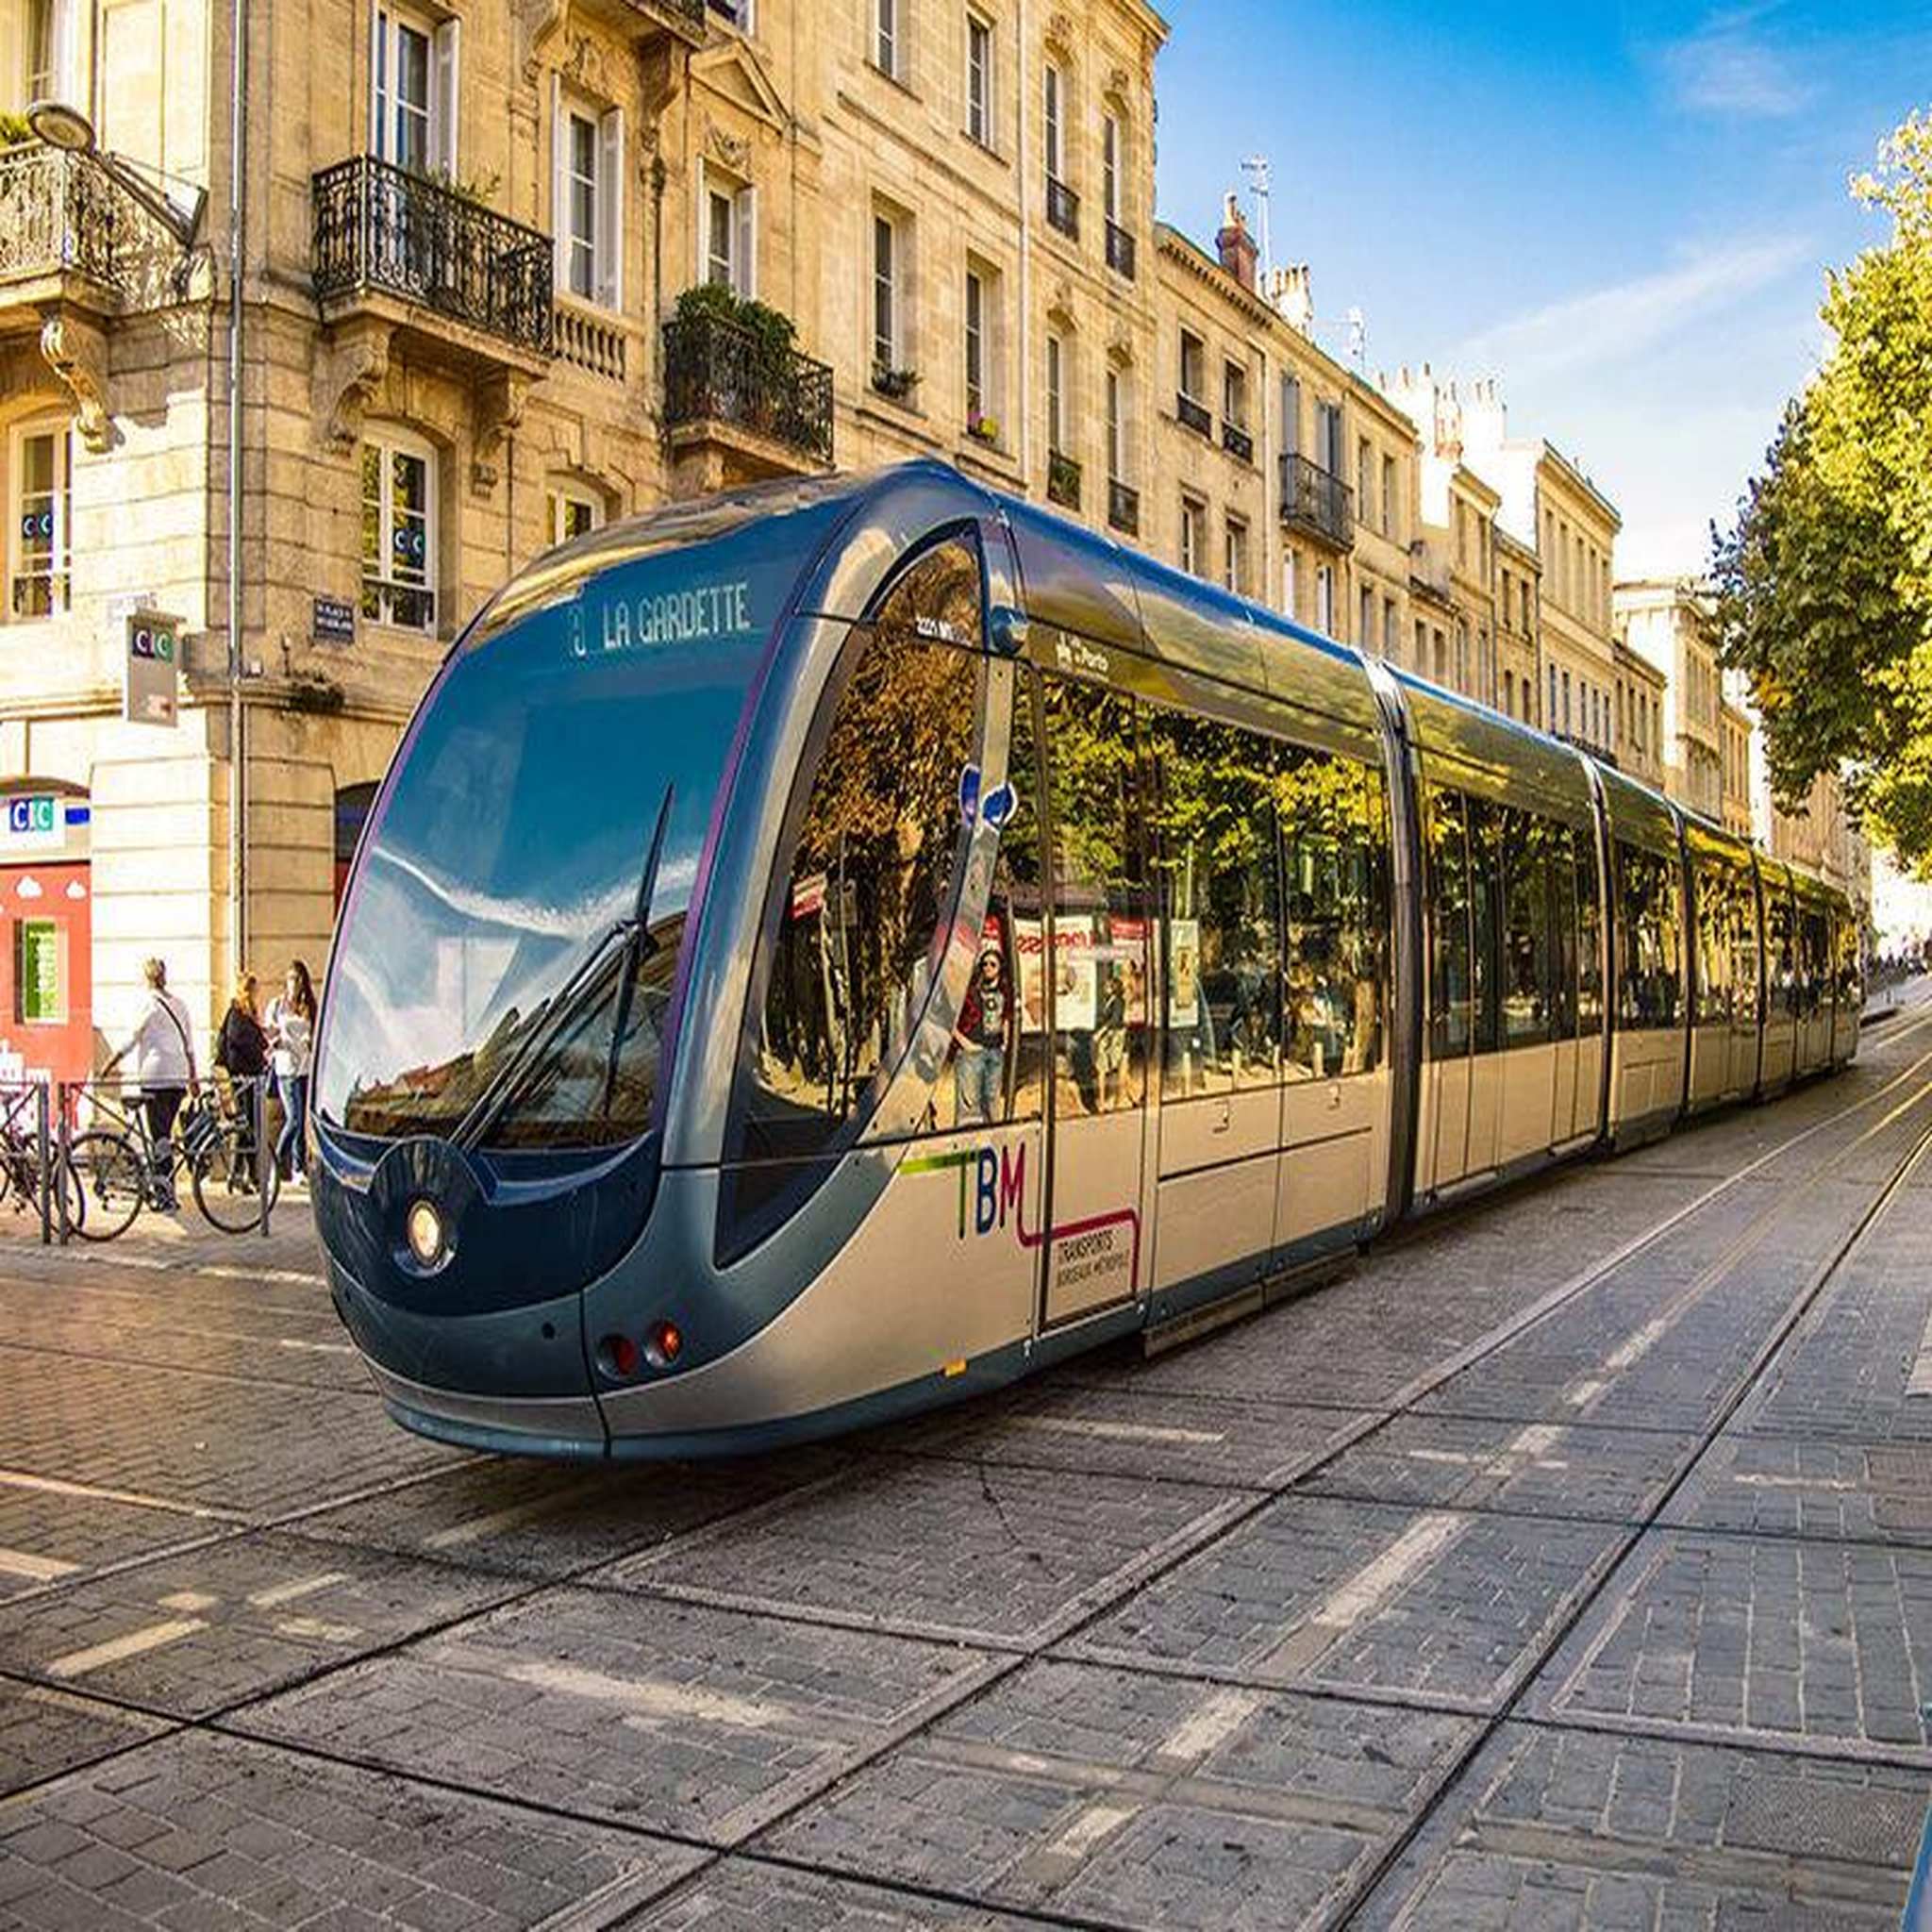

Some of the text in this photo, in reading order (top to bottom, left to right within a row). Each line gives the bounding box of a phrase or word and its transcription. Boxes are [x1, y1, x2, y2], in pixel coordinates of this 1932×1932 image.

[23, 514, 51, 537] CC
[603, 601, 631, 648] LA
[638, 581, 751, 643] GARDETTE
[135, 629, 171, 658] CIC
[12, 799, 51, 830] CIC
[941, 1141, 1029, 1245] TBM
